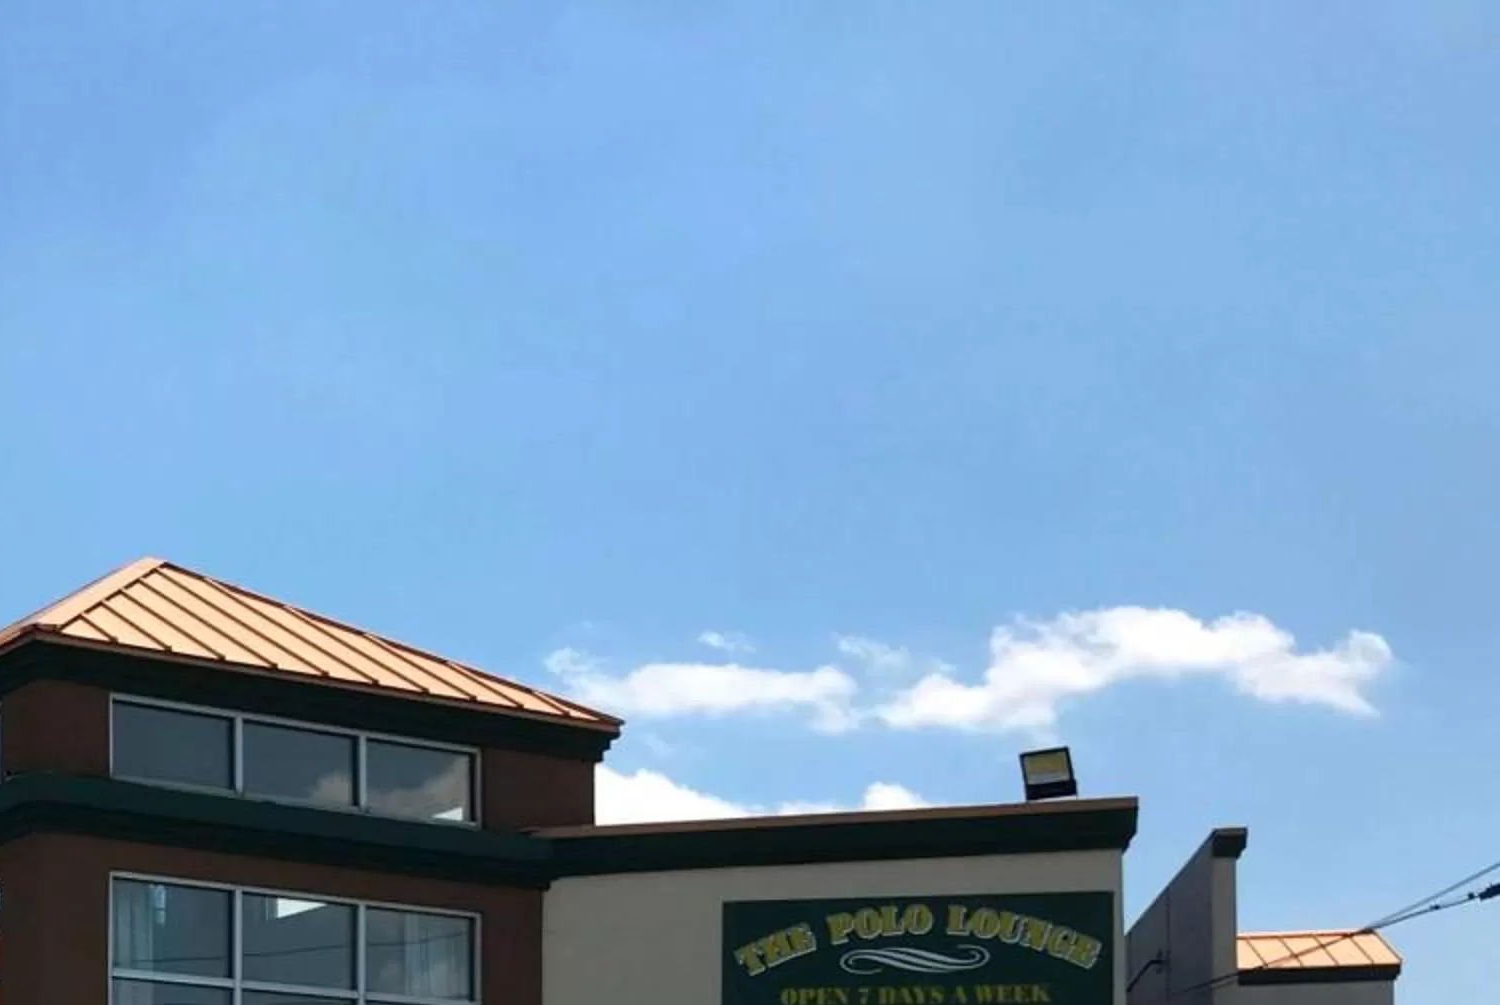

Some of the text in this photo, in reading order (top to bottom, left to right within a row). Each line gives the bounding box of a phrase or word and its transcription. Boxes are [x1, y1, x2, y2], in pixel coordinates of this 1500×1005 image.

[734, 904, 1102, 976] THE POLO LOUNGE
[781, 983, 1051, 1005] OPEN 7 DAYS A WEEK
